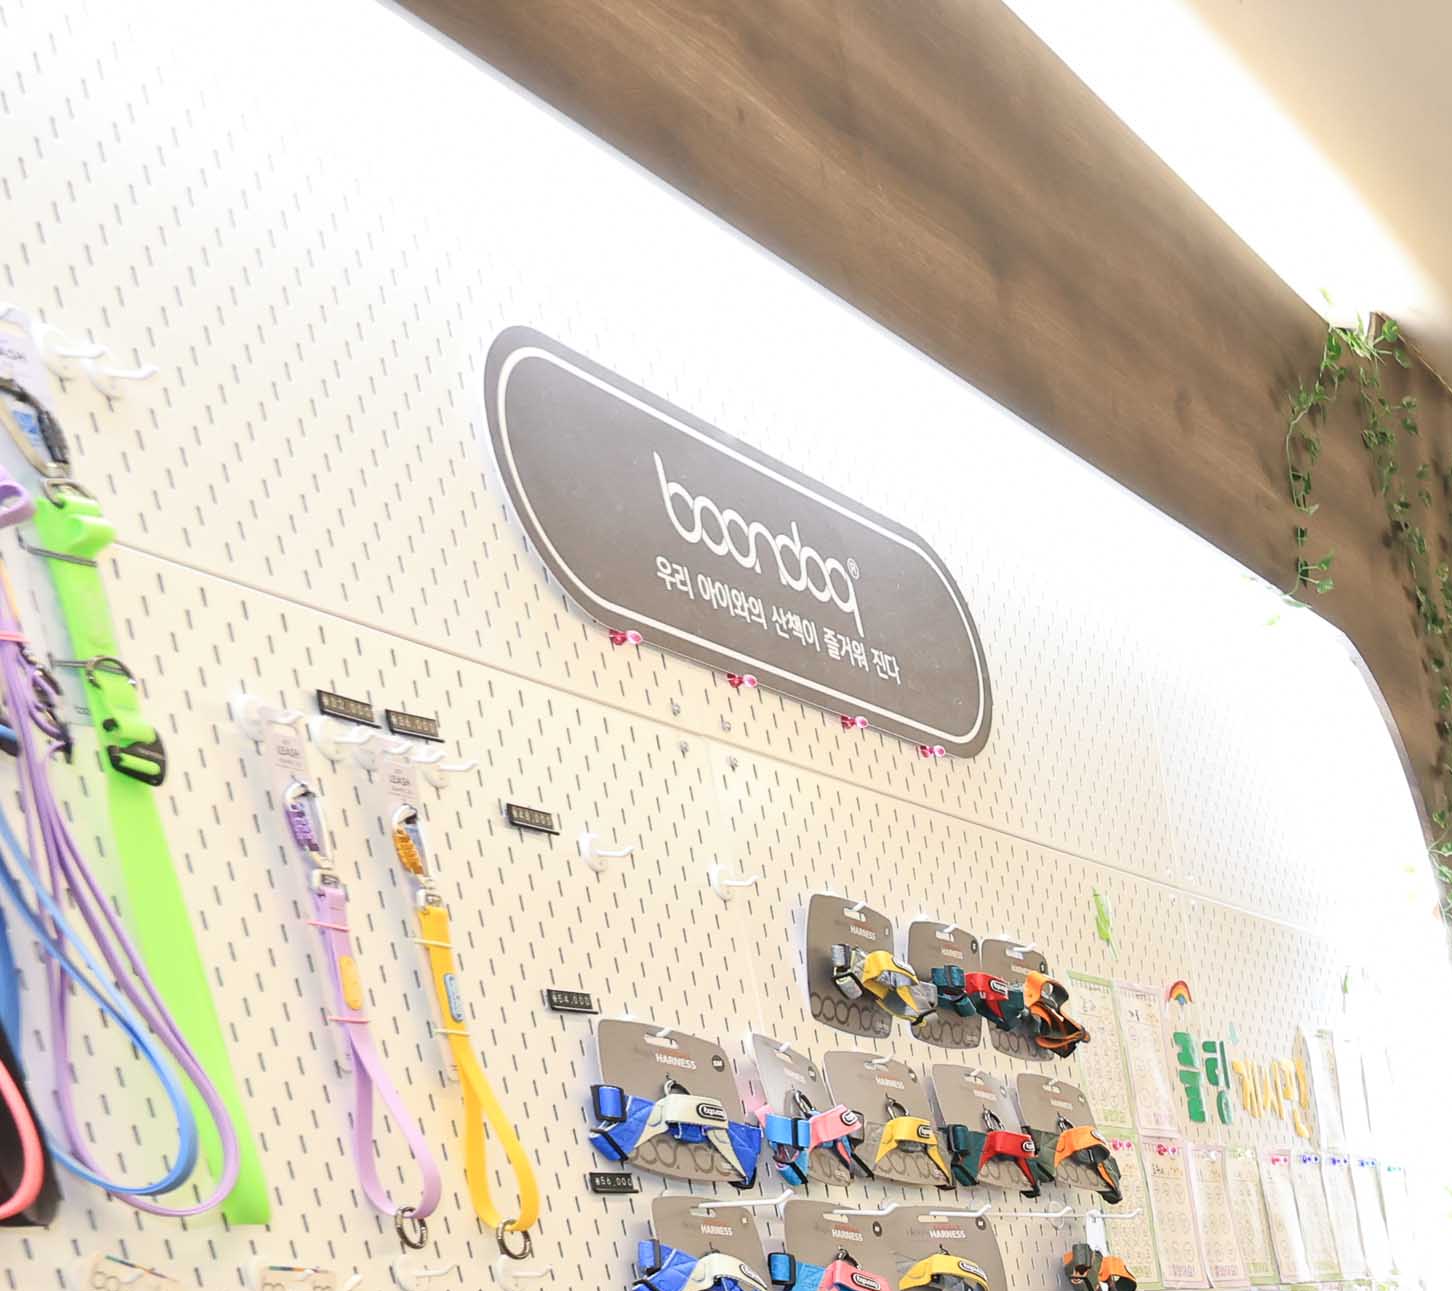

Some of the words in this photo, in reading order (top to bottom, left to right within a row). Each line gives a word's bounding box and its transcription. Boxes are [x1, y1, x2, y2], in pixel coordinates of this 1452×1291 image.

[655, 556, 694, 599] 우리
[697, 574, 768, 629] 아이와의
[771, 606, 820, 652] 산책이
[823, 627, 869, 673] 즐거워
[871, 648, 902, 685] 진다
[655, 1053, 697, 1070] HARNESS
[700, 1223, 733, 1237] HARNESS
[831, 1227, 864, 1242] HARNESS
[929, 1227, 967, 1240] HARNESS
